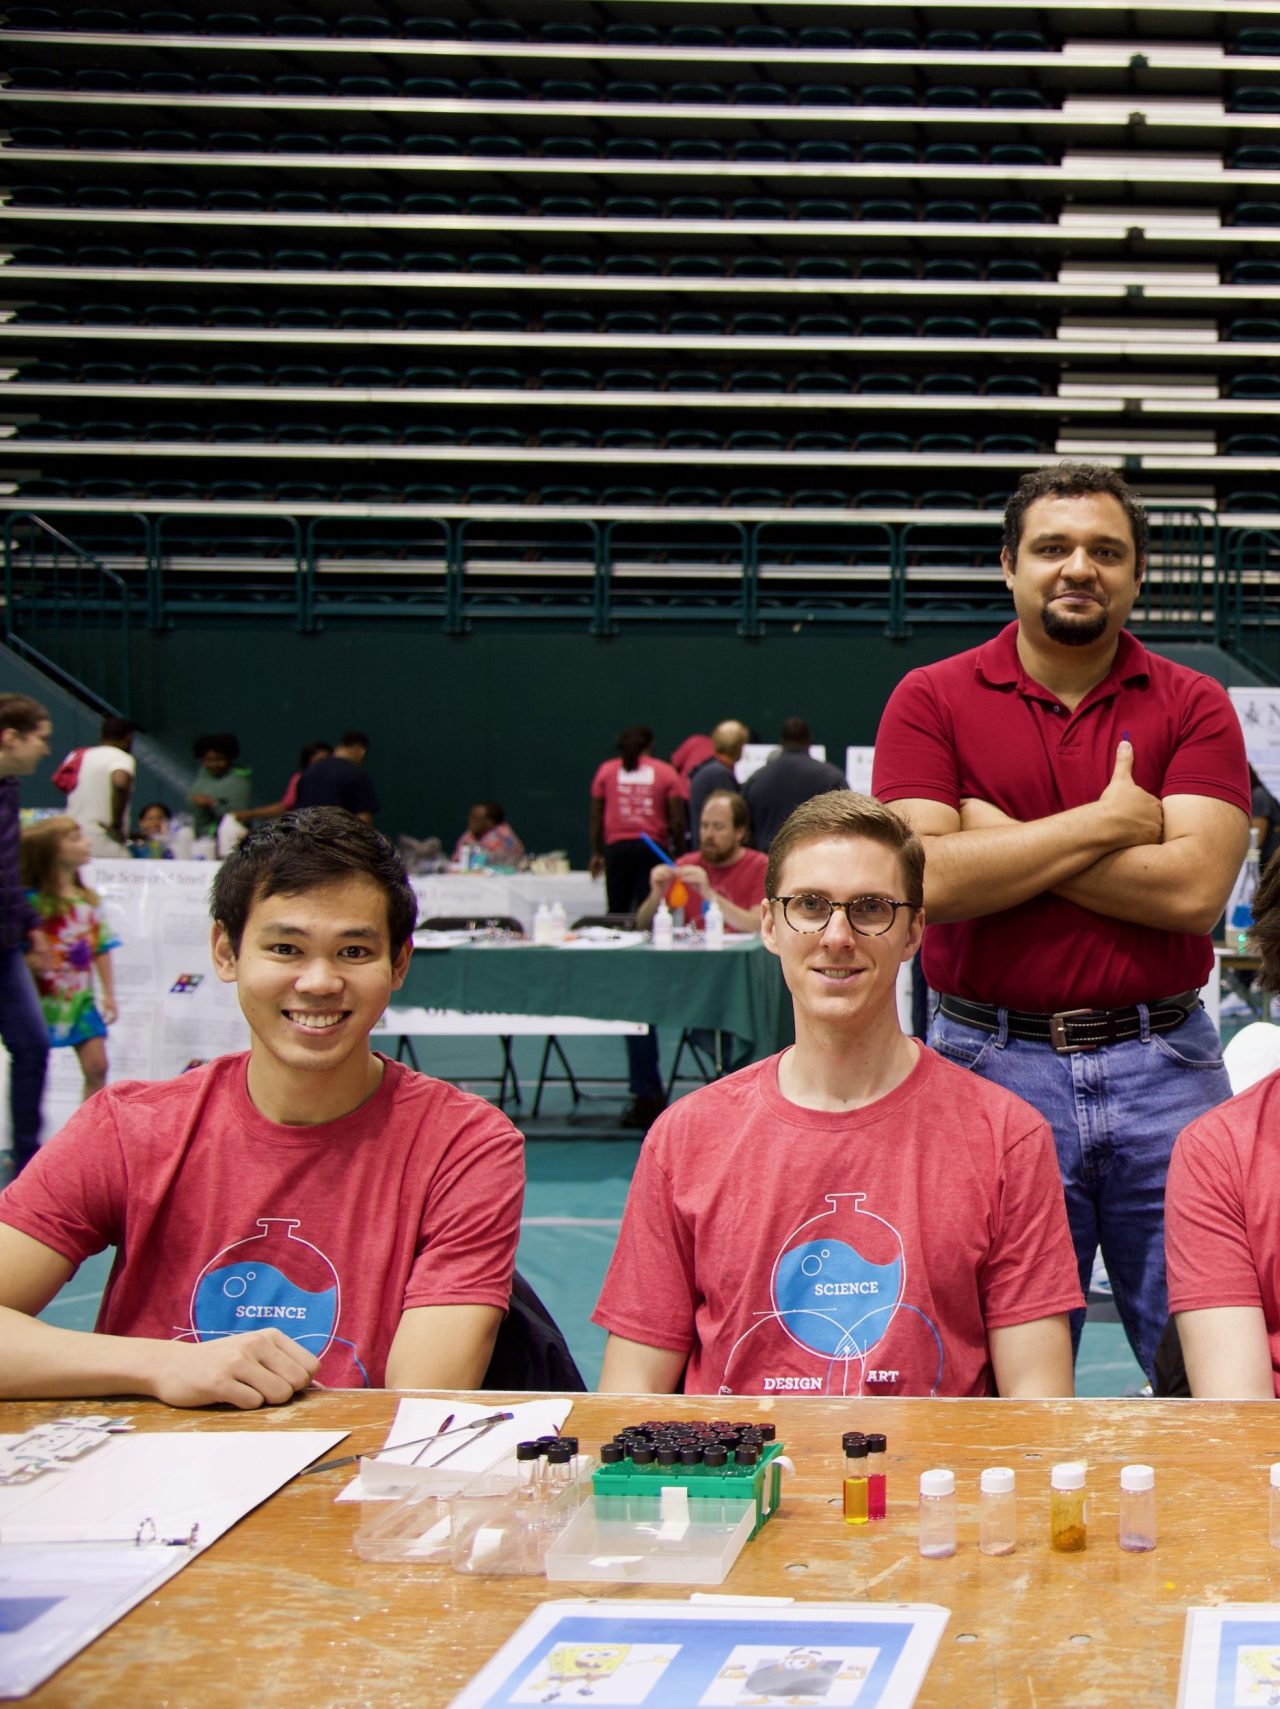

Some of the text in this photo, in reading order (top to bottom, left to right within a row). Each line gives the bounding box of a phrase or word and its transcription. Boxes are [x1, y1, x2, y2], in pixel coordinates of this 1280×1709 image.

[815, 1281, 879, 1296] SCIENCE
[235, 1305, 307, 1320] SCIENCE
[866, 1370, 899, 1382] ART
[763, 1377, 823, 1390] DESIGN
